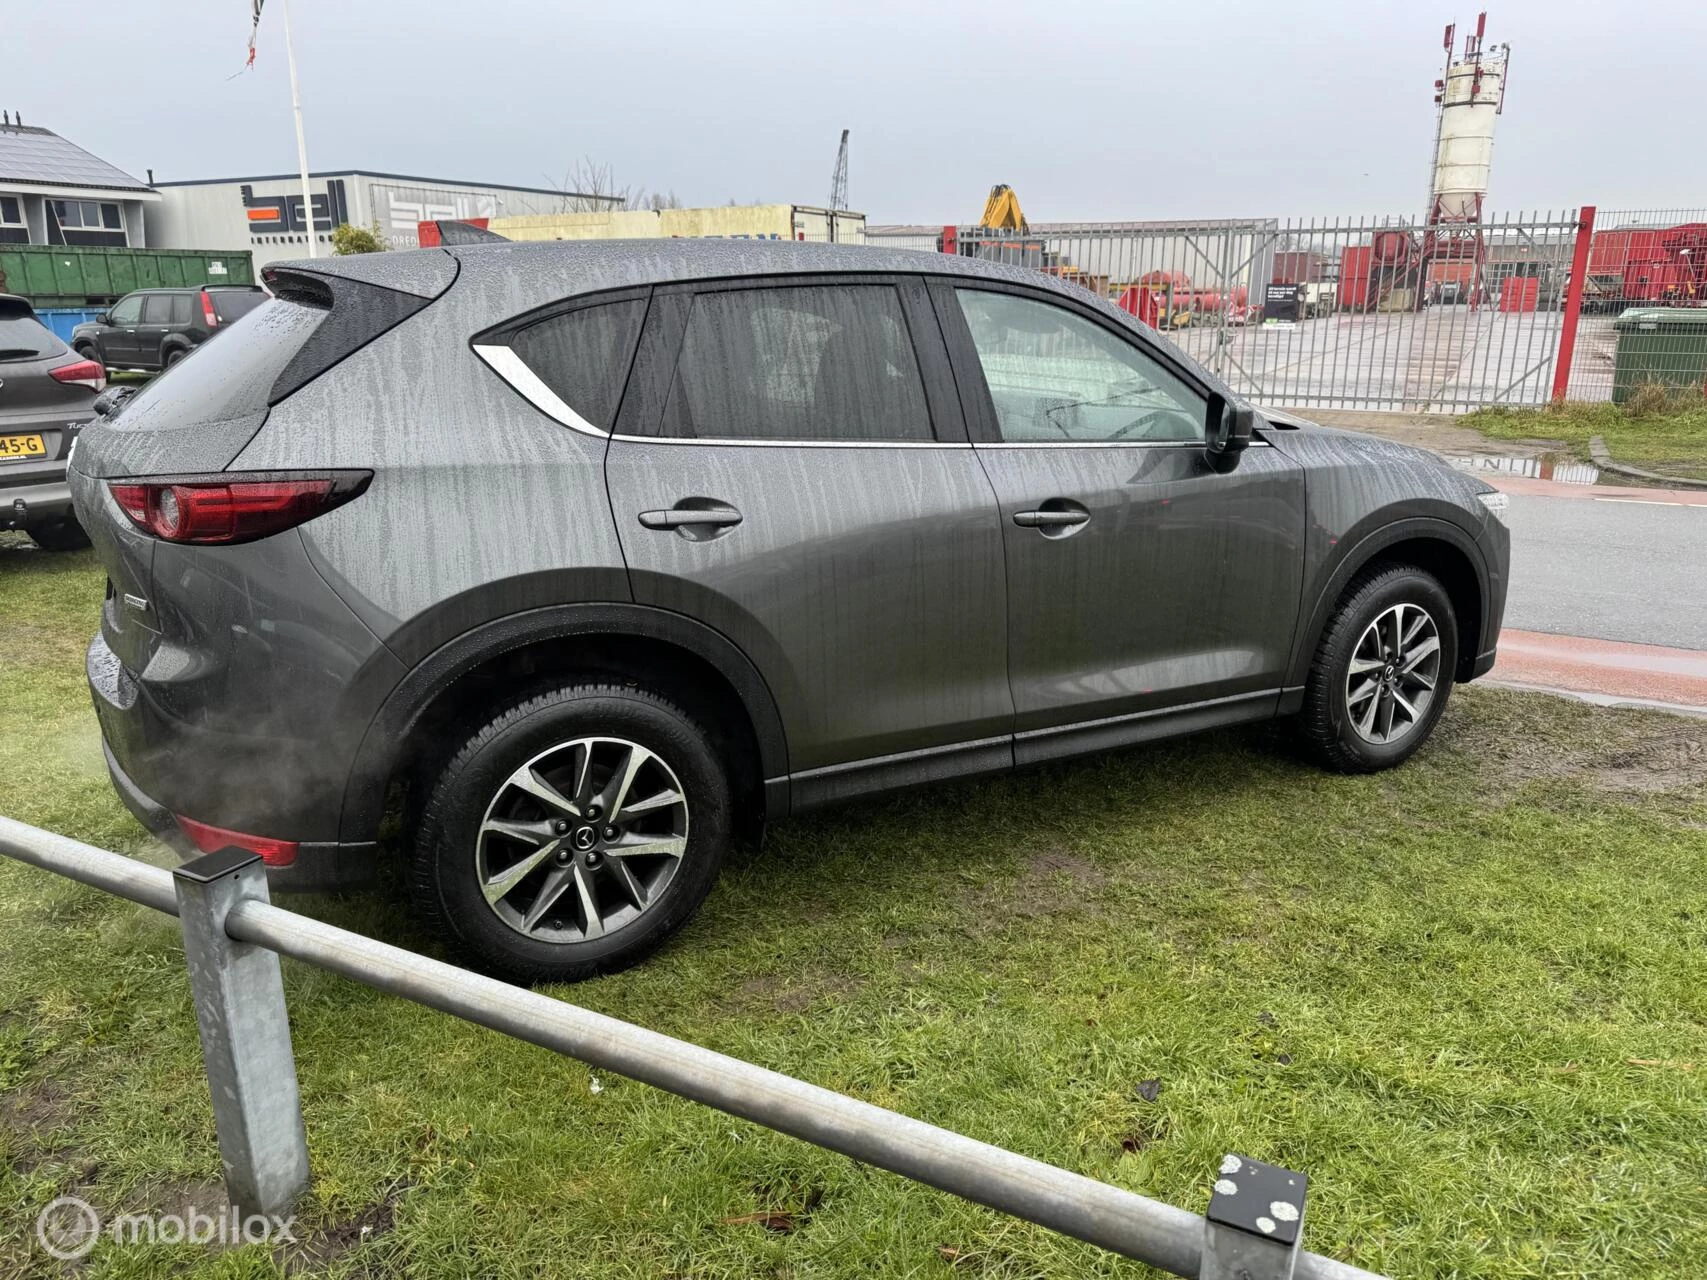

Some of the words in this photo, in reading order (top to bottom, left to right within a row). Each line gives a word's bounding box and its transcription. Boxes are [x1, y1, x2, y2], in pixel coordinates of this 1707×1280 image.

[240, 179, 349, 233] bell
[250, 234, 334, 245] INTERNATON
[391, 235, 418, 247] DRED
